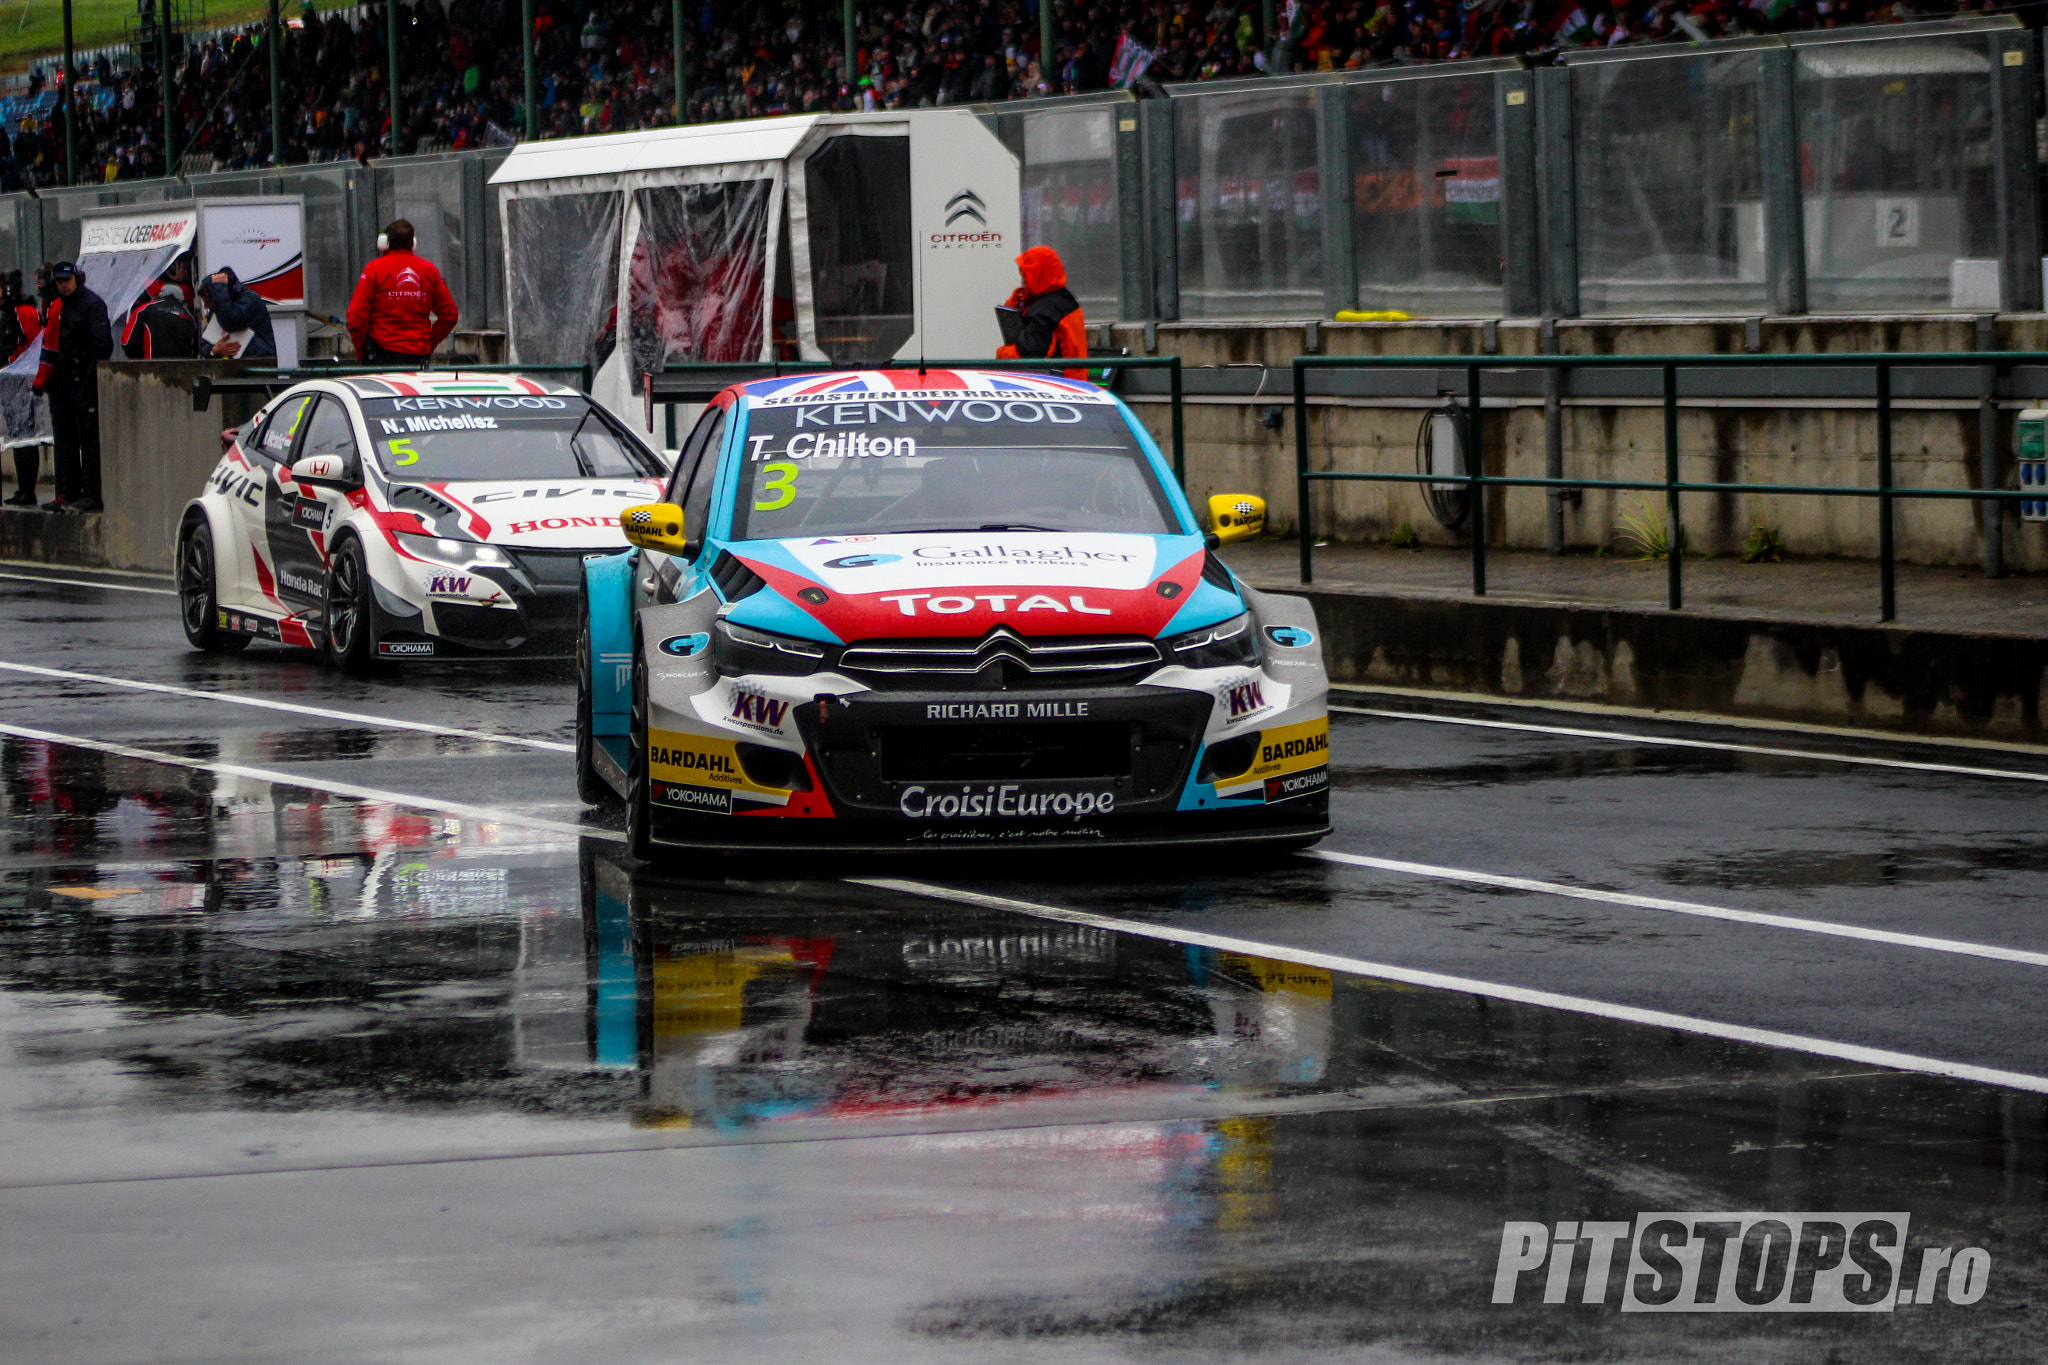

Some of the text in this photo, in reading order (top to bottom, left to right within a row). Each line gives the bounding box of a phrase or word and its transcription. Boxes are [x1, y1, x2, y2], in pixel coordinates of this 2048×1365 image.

[1888, 208, 1907, 238] 2
[392, 396, 567, 412] KENWOOD
[796, 400, 1083, 428] KENWOOD
[380, 415, 498, 434] N. Michelisz
[388, 438, 419, 466] 5
[748, 431, 916, 461] T. Chilton
[472, 487, 661, 504] CIVIC
[755, 462, 800, 511] 3
[507, 516, 622, 535] HOND
[625, 523, 664, 537] BARDAHL
[912, 546, 1137, 562] Gallagher
[916, 559, 1089, 567] Insurance Brokers
[281, 570, 308, 593] Honda
[430, 576, 472, 594] KW
[880, 593, 1112, 616] TOTAL
[389, 644, 432, 653] YOKOHAMA
[732, 691, 790, 728] KW
[1229, 680, 1266, 717] KW
[926, 702, 1089, 719] RICHARD MILLE
[722, 715, 785, 736] kwsuspensions.de
[1262, 733, 1328, 762] BARDAHL
[651, 746, 735, 774] BARDAHL
[708, 772, 743, 785] Additives
[1282, 769, 1328, 793] YOKOHAMA
[666, 787, 728, 808] YOKOHAMA
[900, 784, 1115, 822] CroisiEurope
